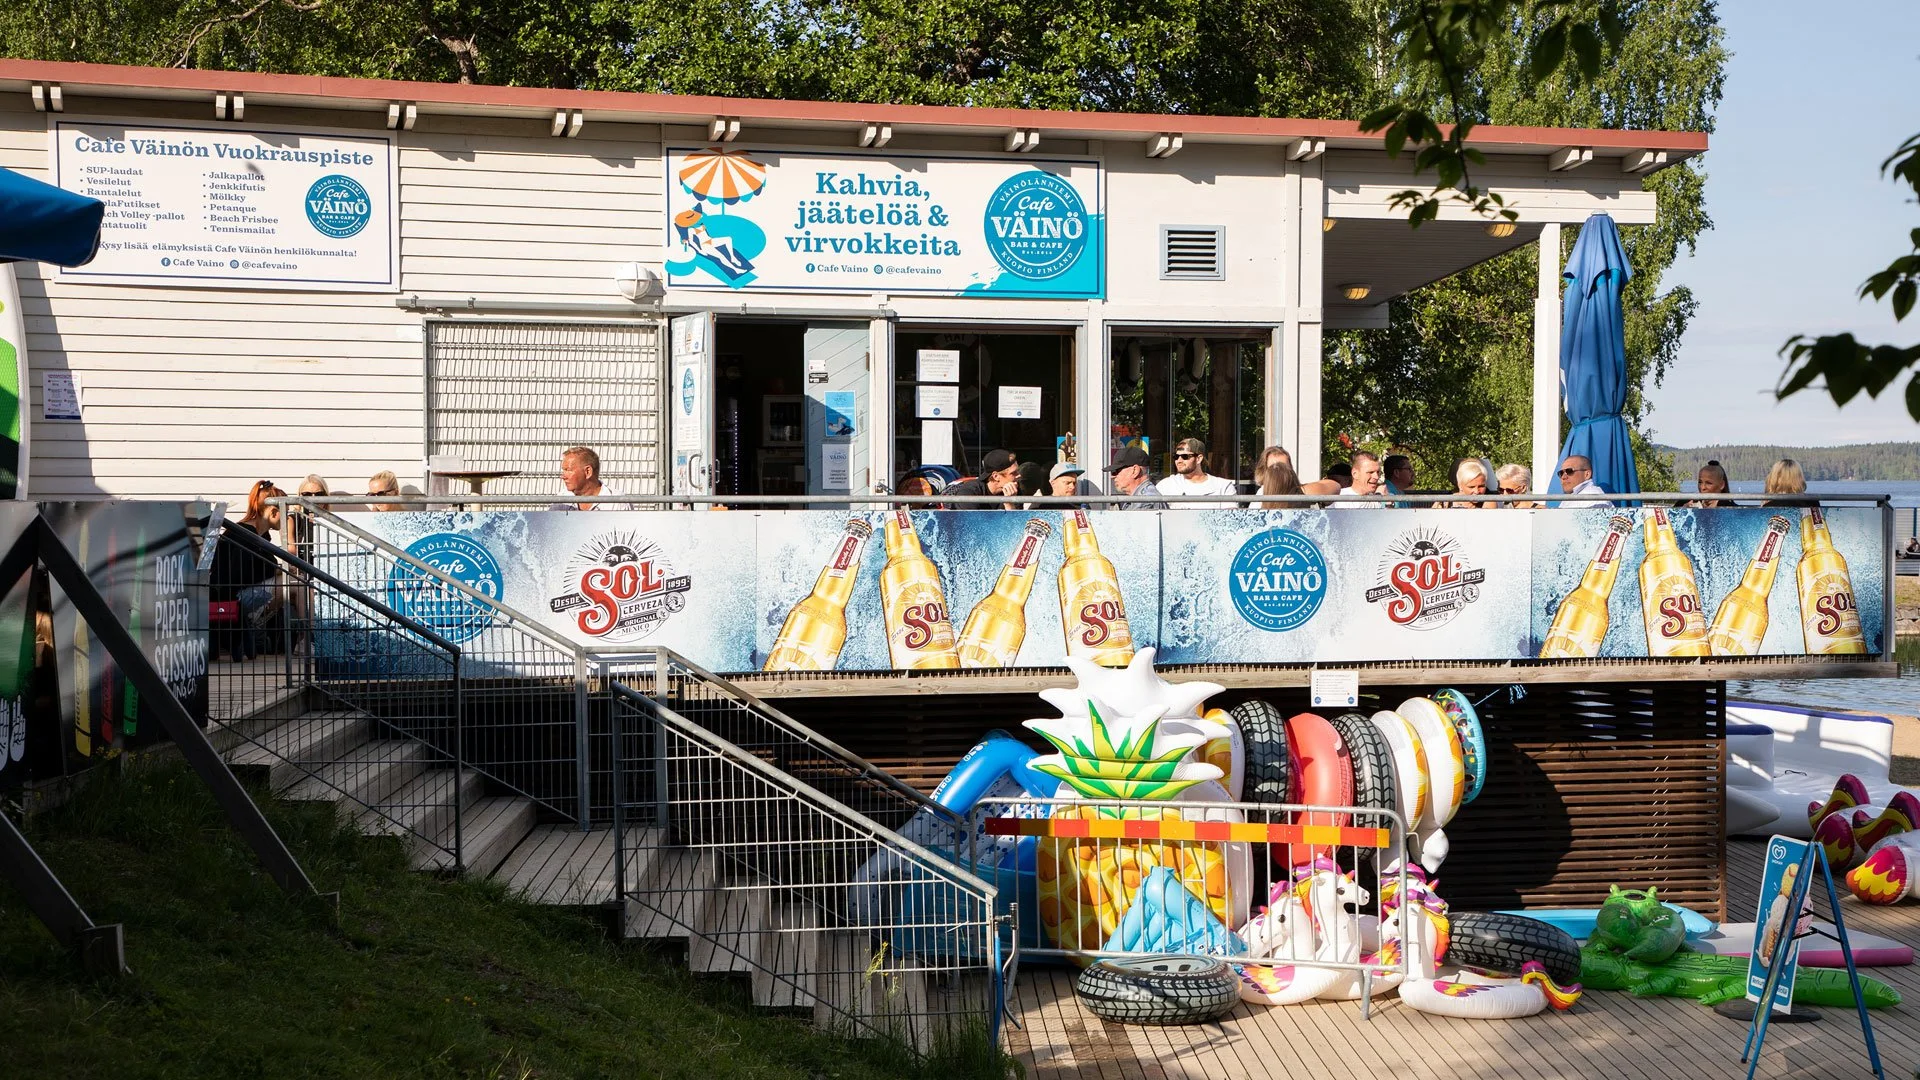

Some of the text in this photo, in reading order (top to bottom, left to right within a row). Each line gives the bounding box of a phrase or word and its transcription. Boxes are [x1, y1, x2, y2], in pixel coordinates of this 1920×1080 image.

[75, 136, 374, 168] Cafe Väinön Vuokrauspiste
[86, 166, 144, 176] SUP-laudat
[208, 171, 265, 182] Jalkapallot
[87, 177, 132, 186] Vesilelut
[209, 182, 266, 192] Jenkkifutis
[815, 172, 931, 201] Kahvia,
[87, 188, 142, 197] Rantalelut
[209, 193, 246, 203] Mölkky
[326, 188, 350, 200] Cafe
[1000, 177, 1074, 204] VÄINÖLÄNNIEMI
[210, 203, 257, 214] Petanque
[309, 197, 368, 215] VÄINÖ
[1017, 195, 1056, 215] Cafe
[120, 211, 151, 221] Volley
[152, 213, 186, 221] -pallot
[210, 214, 279, 225] Beach Frisbee
[794, 200, 949, 229] jäätelöä &
[102, 222, 148, 230] ntatuolit
[210, 225, 276, 235] Tennismailat
[990, 210, 1083, 240] VÄINÖ
[99, 241, 358, 258] Kysy lisää elämyksistä Cafe Väinön henkilökunnalta!
[784, 230, 962, 256] virvokkeita
[1031, 241, 1037, 249] &
[173, 258, 298, 271] Cafe Vaino @cafevaino
[817, 264, 942, 275] Cafe Vaino @cafevaino
[1001, 250, 1074, 275] KUOPIO FINLAND
[415, 541, 488, 567] INÖLÄNNIEMI
[1244, 535, 1315, 560] VÄINÖLÄNNIEMI
[1261, 552, 1297, 570] Cafe
[155, 554, 185, 596] ROCK
[667, 577, 688, 590] 1899
[1235, 565, 1322, 593] VÄINÖ
[1463, 569, 1482, 581] 1899
[1368, 586, 1391, 599] DESDE
[1425, 589, 1461, 605] CERVEZA
[554, 595, 581, 609] DESDE
[622, 598, 663, 615] CERVEZA
[1426, 603, 1455, 616] ORIGINAL
[154, 597, 190, 641] PAPER
[624, 613, 658, 627] ORIGINAL
[1244, 603, 1313, 626] KUOPIO FINLAND
[1659, 594, 1702, 638] SOL
[1815, 592, 1857, 636] SOL
[902, 602, 949, 649] SOL
[1080, 600, 1127, 647] SOL
[154, 637, 206, 684] SCISSORS
